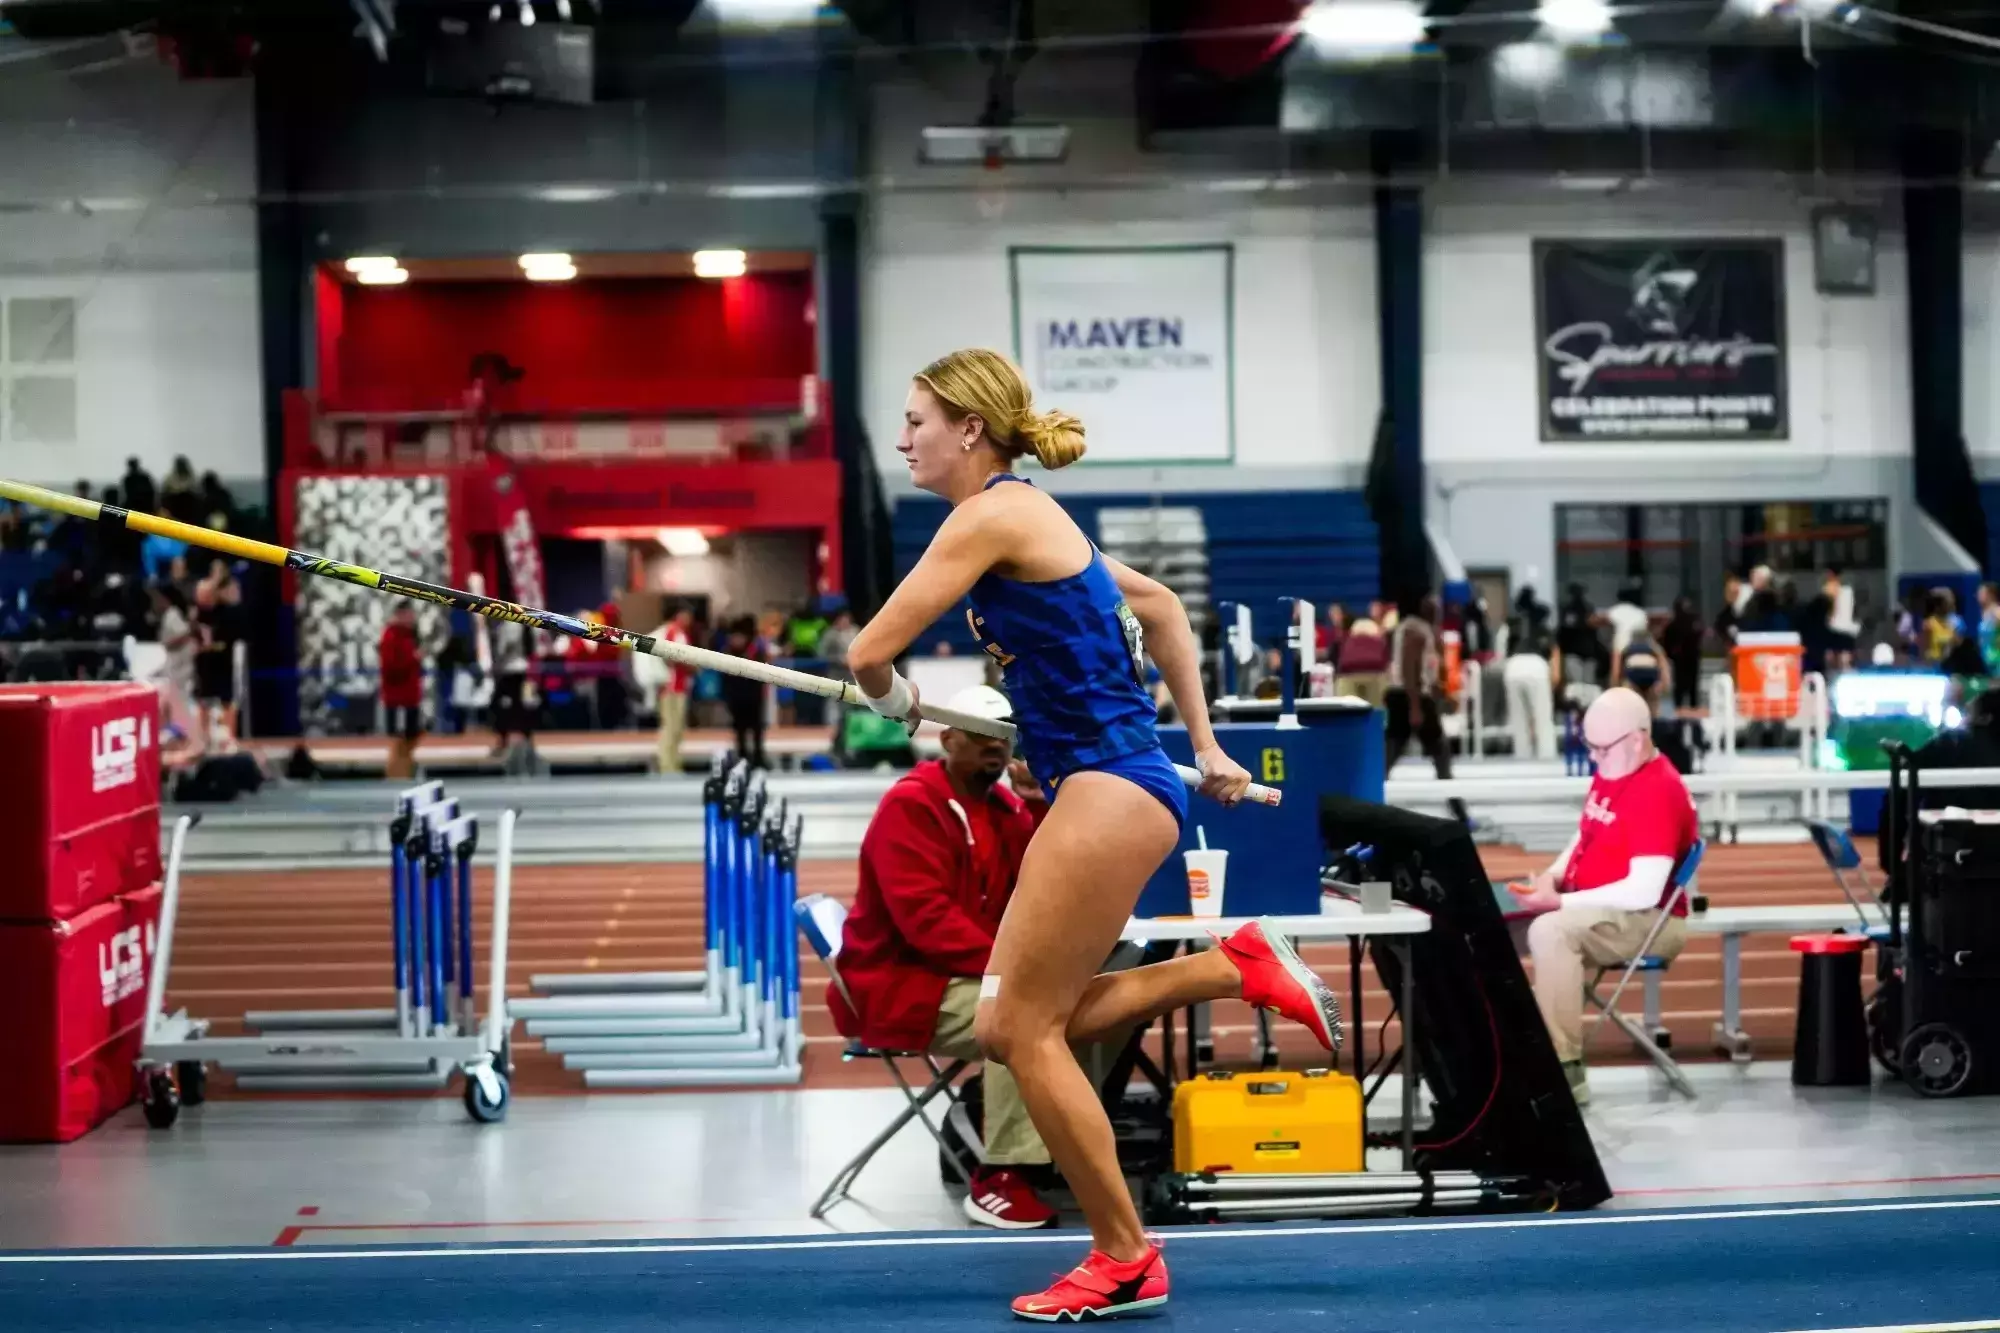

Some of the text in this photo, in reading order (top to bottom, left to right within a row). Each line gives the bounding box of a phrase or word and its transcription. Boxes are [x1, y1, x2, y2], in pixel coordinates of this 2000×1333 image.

[1049, 315, 1183, 349] MAVEN
[91, 716, 137, 772] UCS
[1262, 748, 1285, 781] 6
[99, 925, 143, 985] UCS
